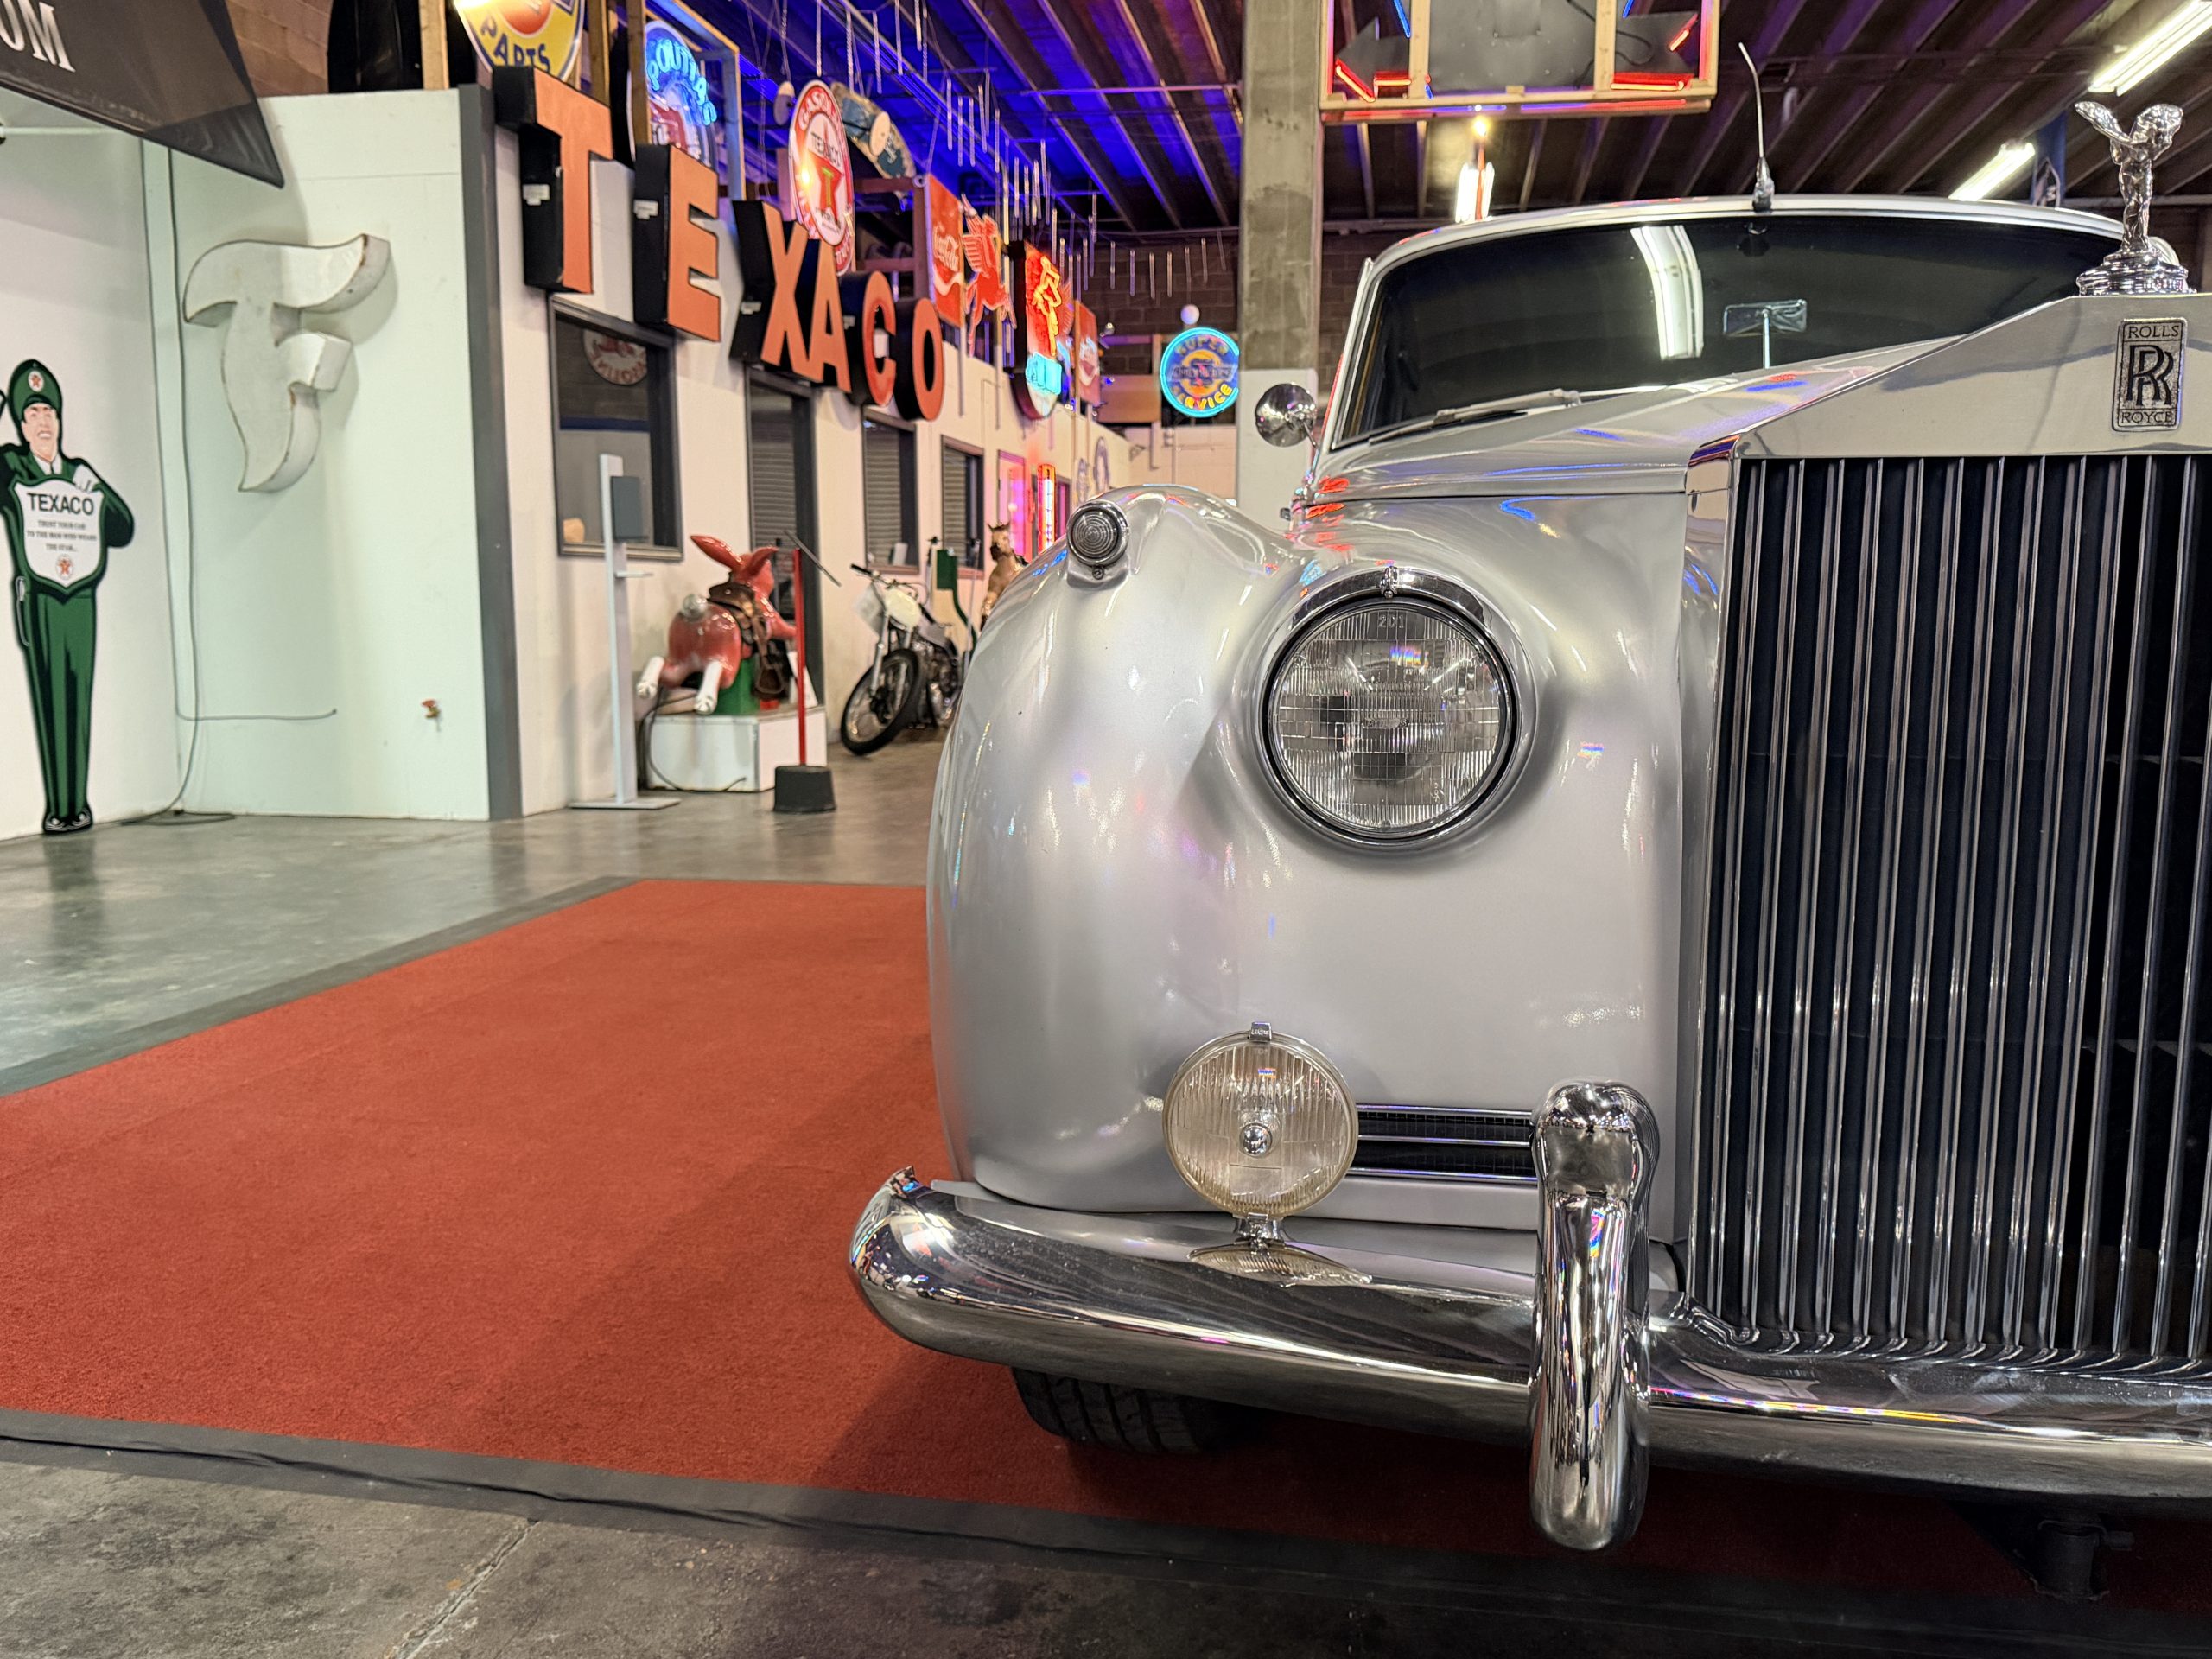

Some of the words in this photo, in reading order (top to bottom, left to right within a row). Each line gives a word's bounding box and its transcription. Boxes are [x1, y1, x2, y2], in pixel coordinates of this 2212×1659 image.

[534, 67, 944, 421] TEXACO
[2127, 325, 2180, 340] ROLLS
[1171, 383, 1233, 410] SERVICE
[2120, 411, 2174, 424] ROYCE
[26, 492, 94, 516] TEXACO
